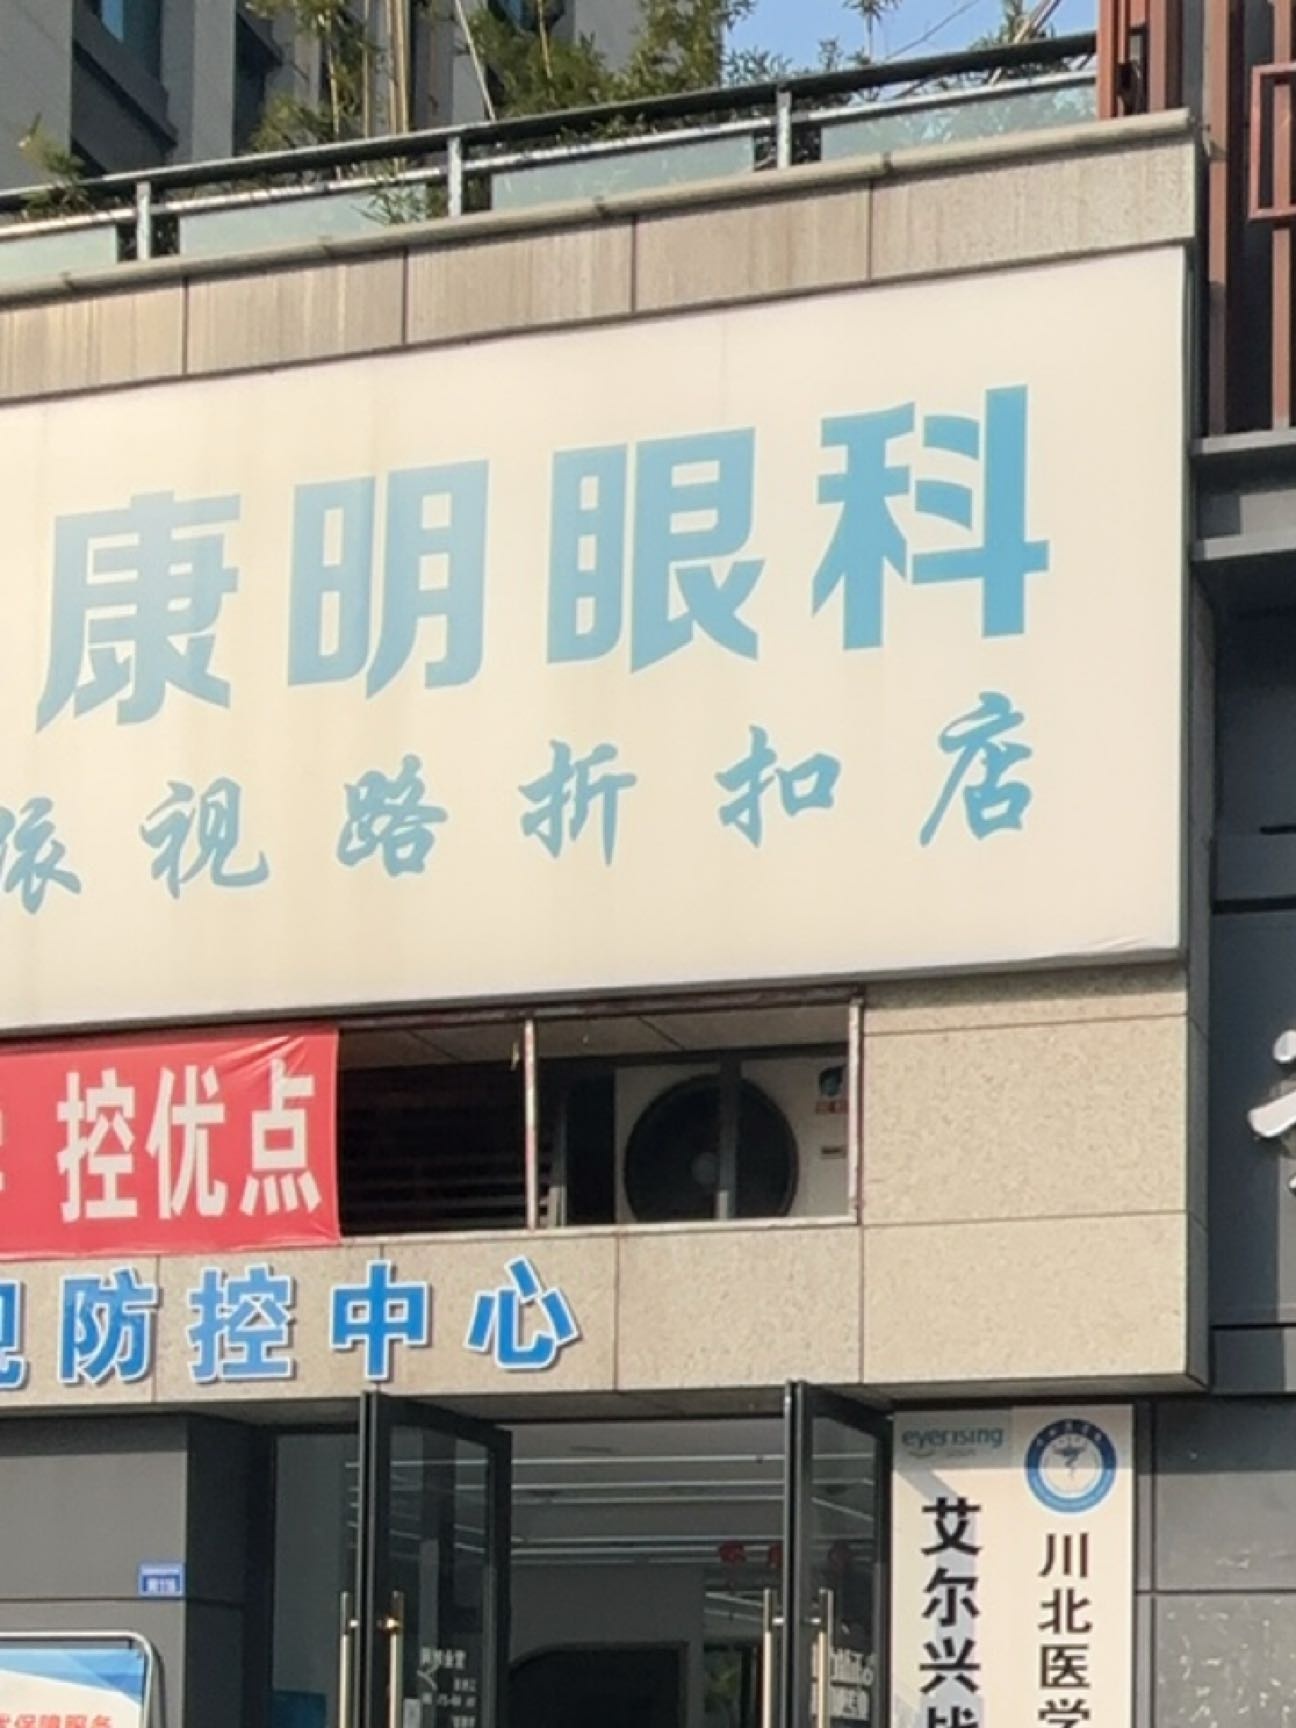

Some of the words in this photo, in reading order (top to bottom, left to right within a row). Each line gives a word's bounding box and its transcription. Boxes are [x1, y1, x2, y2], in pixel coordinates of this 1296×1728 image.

[36, 385, 1051, 733] 康明眼科
[0, 1256, 579, 1389] 防控中心
